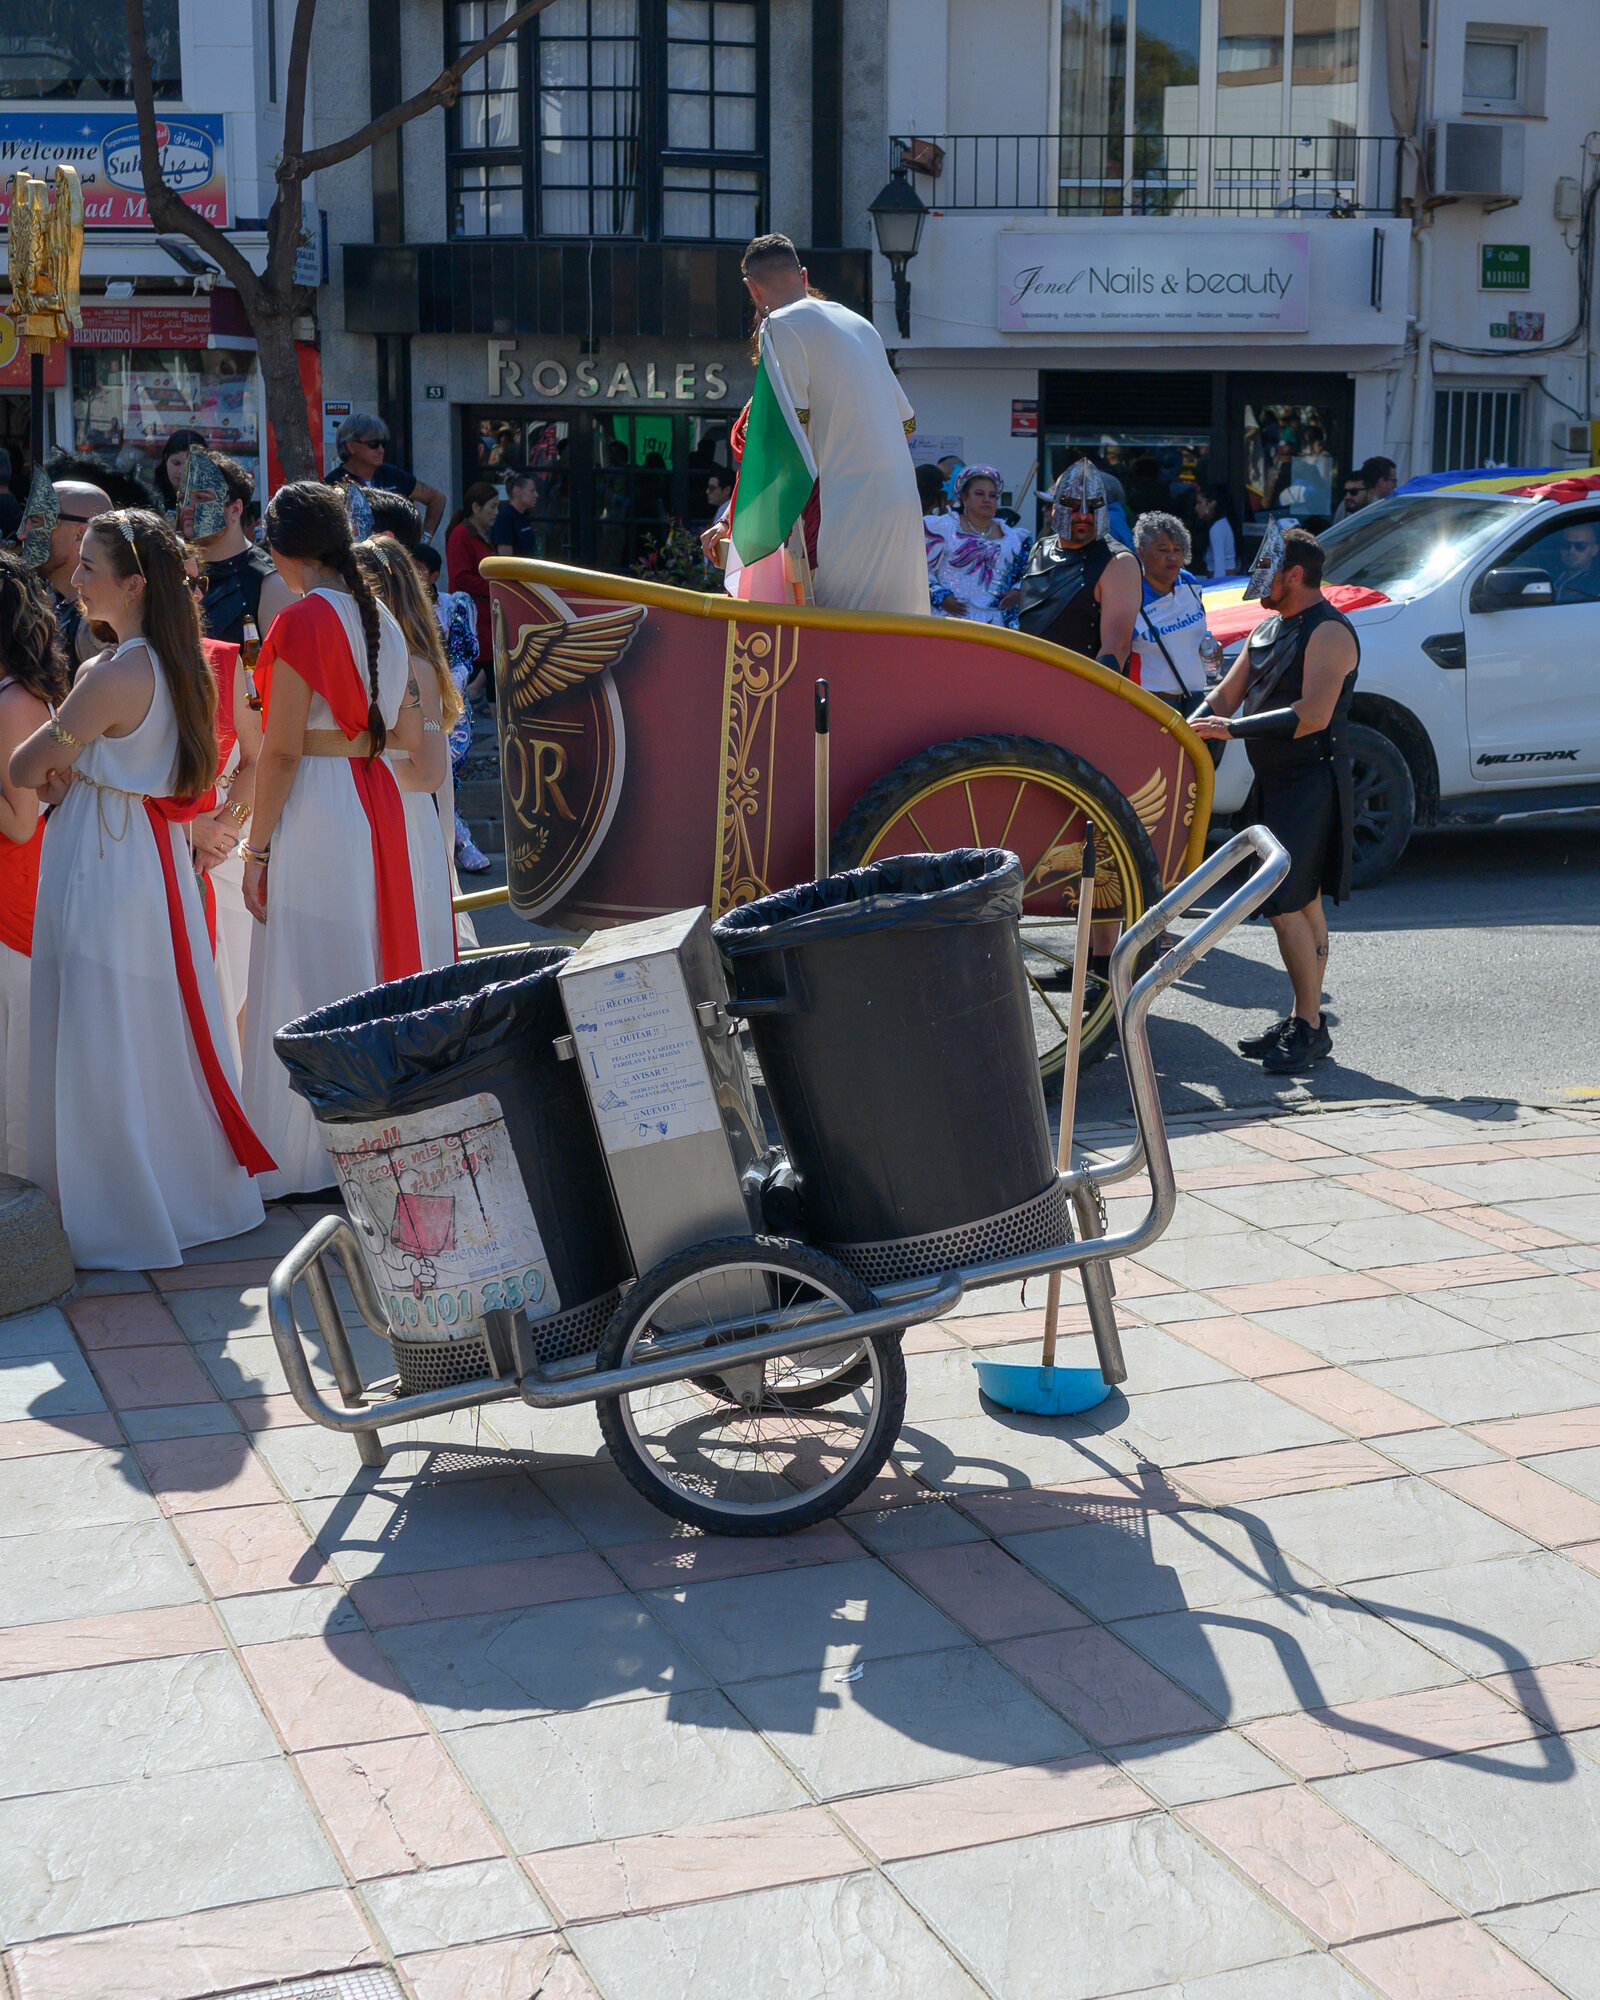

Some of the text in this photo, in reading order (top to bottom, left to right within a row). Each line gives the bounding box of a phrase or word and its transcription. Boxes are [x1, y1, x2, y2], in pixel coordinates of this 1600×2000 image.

[2, 141, 98, 160] Welcome
[1009, 266, 1293, 305] Jenel Nails & beauty
[142, 311, 180, 319] WELCOME
[74, 329, 131, 343] BIENVENIDO
[429, 387, 442, 398] 53
[1477, 748, 1581, 766] WILDTRAK
[620, 1029, 652, 1044] QUITAR
[631, 1068, 661, 1081] AVISAR
[640, 1104, 669, 1117] NUEVO
[411, 1142, 441, 1165] mis
[423, 1289, 471, 1327] 101
[481, 1268, 545, 1312] 889
